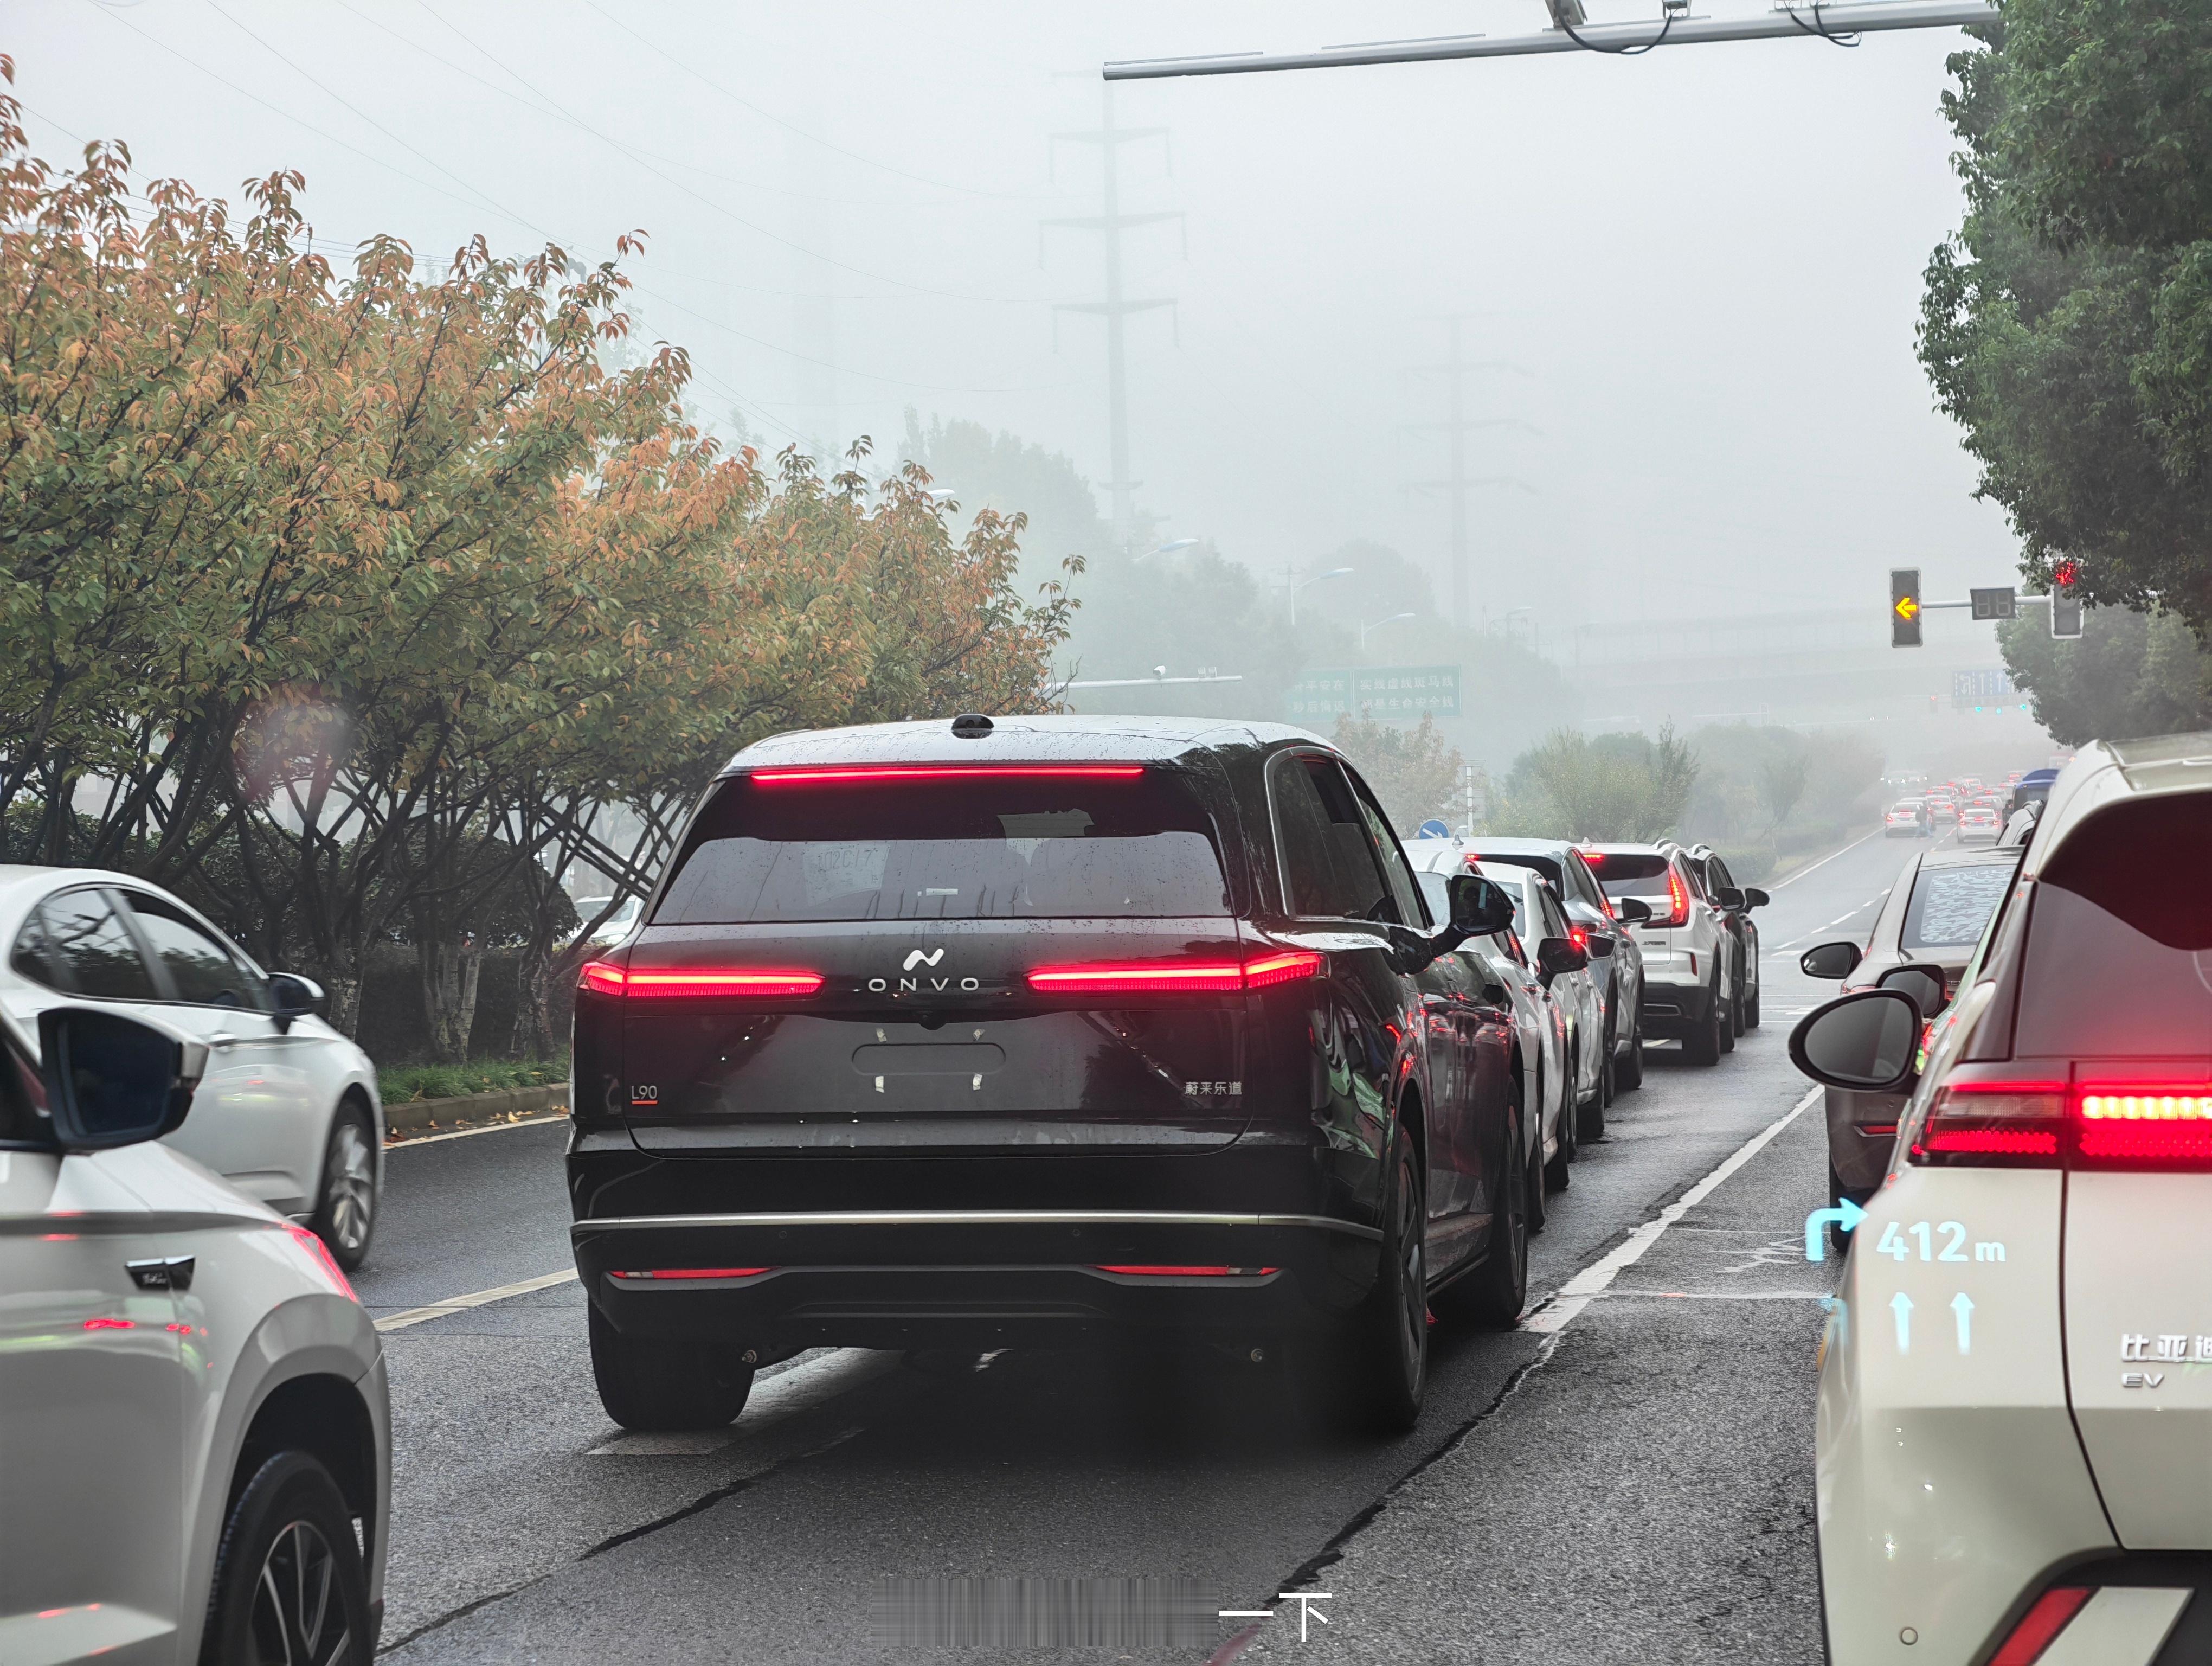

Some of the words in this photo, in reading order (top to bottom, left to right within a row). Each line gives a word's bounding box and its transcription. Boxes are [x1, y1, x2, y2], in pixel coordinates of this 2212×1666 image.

[1360, 676, 1454, 690] 实线虚线斑马线
[868, 978, 979, 992] ONVO
[631, 1085, 658, 1099] L90
[1184, 1081, 1242, 1095] 蔚来乐道
[2121, 1373, 2165, 1388] EV
